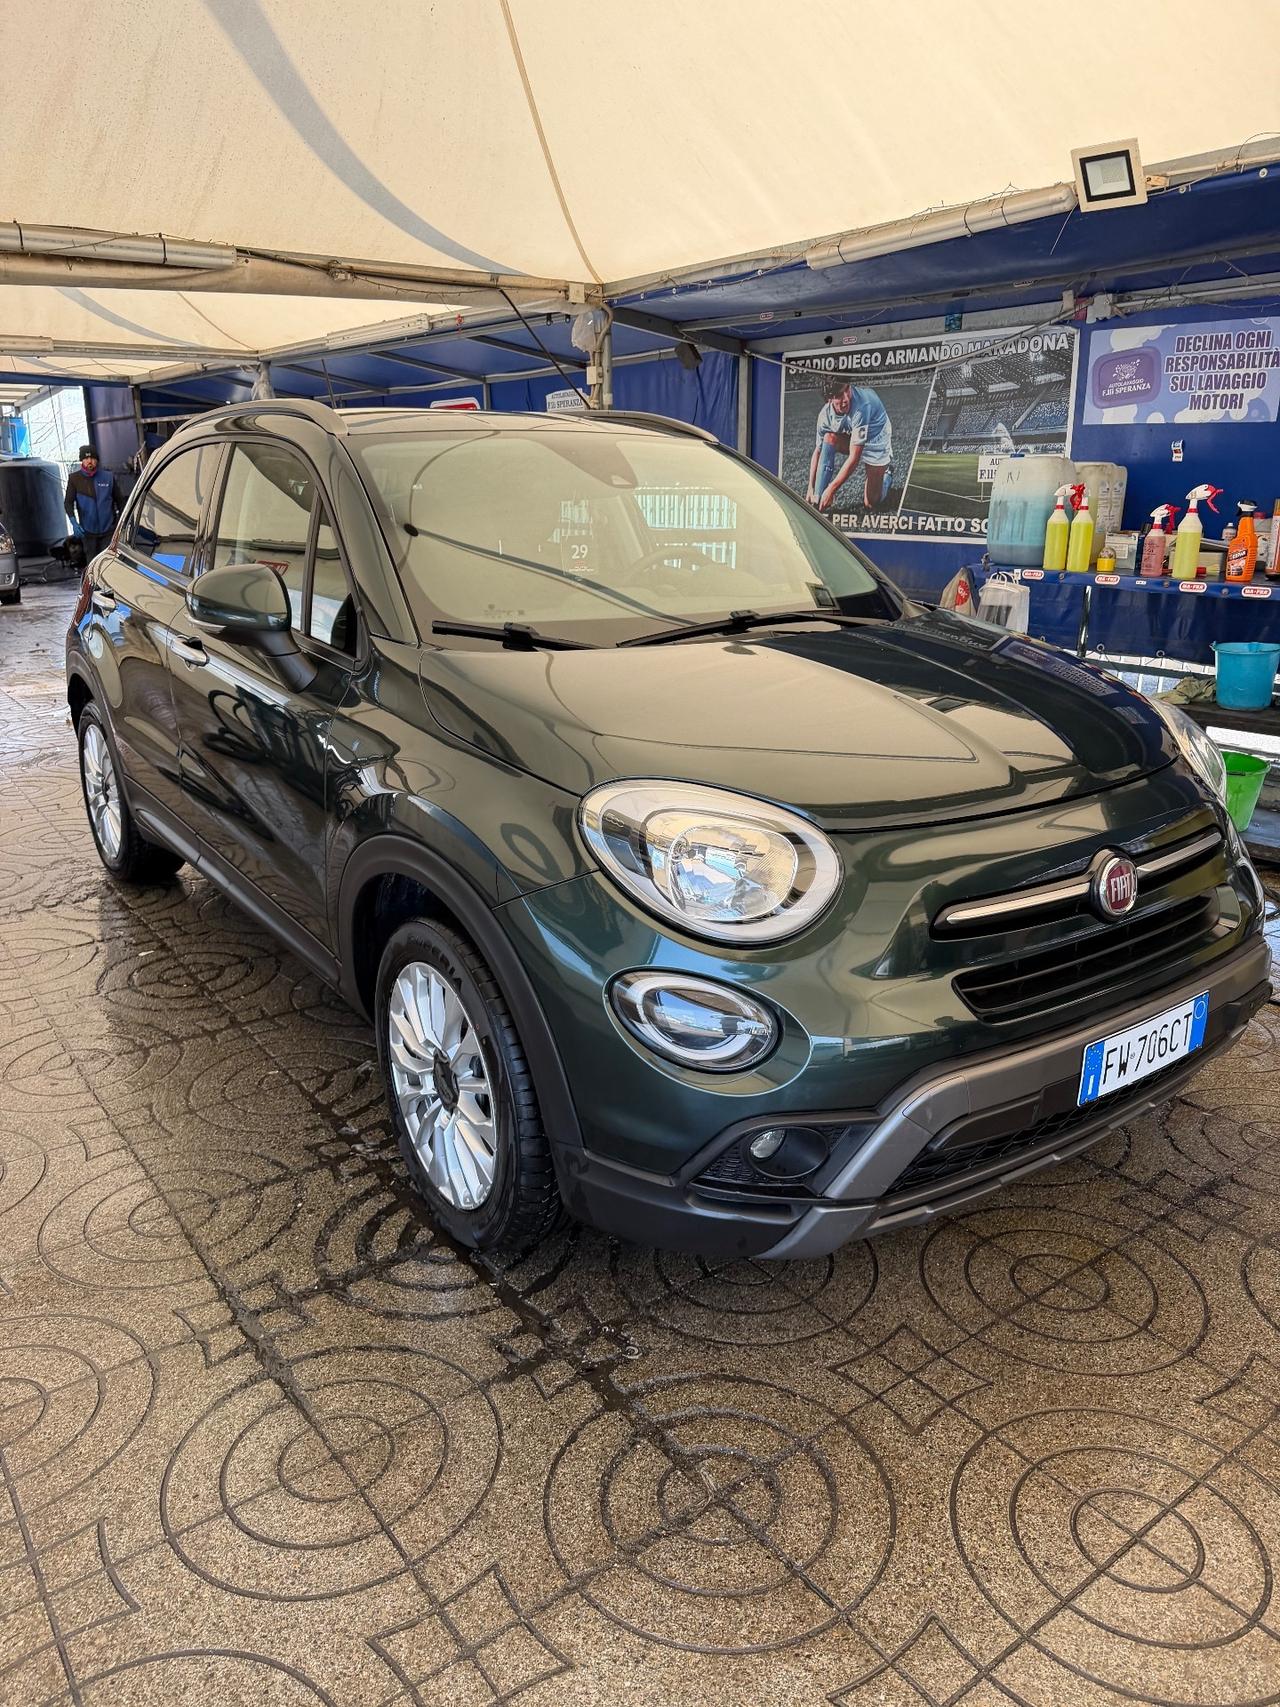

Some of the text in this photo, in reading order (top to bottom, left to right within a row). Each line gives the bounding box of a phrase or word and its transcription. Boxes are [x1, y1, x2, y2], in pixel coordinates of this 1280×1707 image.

[1175, 330, 1272, 353] DECLINA OGNI
[789, 357, 835, 374] STADIO
[838, 352, 882, 370] DIEGO
[885, 342, 964, 366] ARMANDO
[1165, 348, 1280, 373] RESPONSABILITÀ
[1115, 382, 1151, 394] SPERANZA
[1170, 372, 1267, 392] SUL LAVAGGIO
[556, 399, 583, 409] SPERANZA
[1189, 393, 1244, 411] MOTORI
[989, 458, 1000, 466] AU
[832, 513, 989, 534] PER AVERCI FATTO SO
[571, 544, 588, 559] 29
[1110, 873, 1131, 903] FIAT
[1102, 1012, 1193, 1085] FW 706CT
